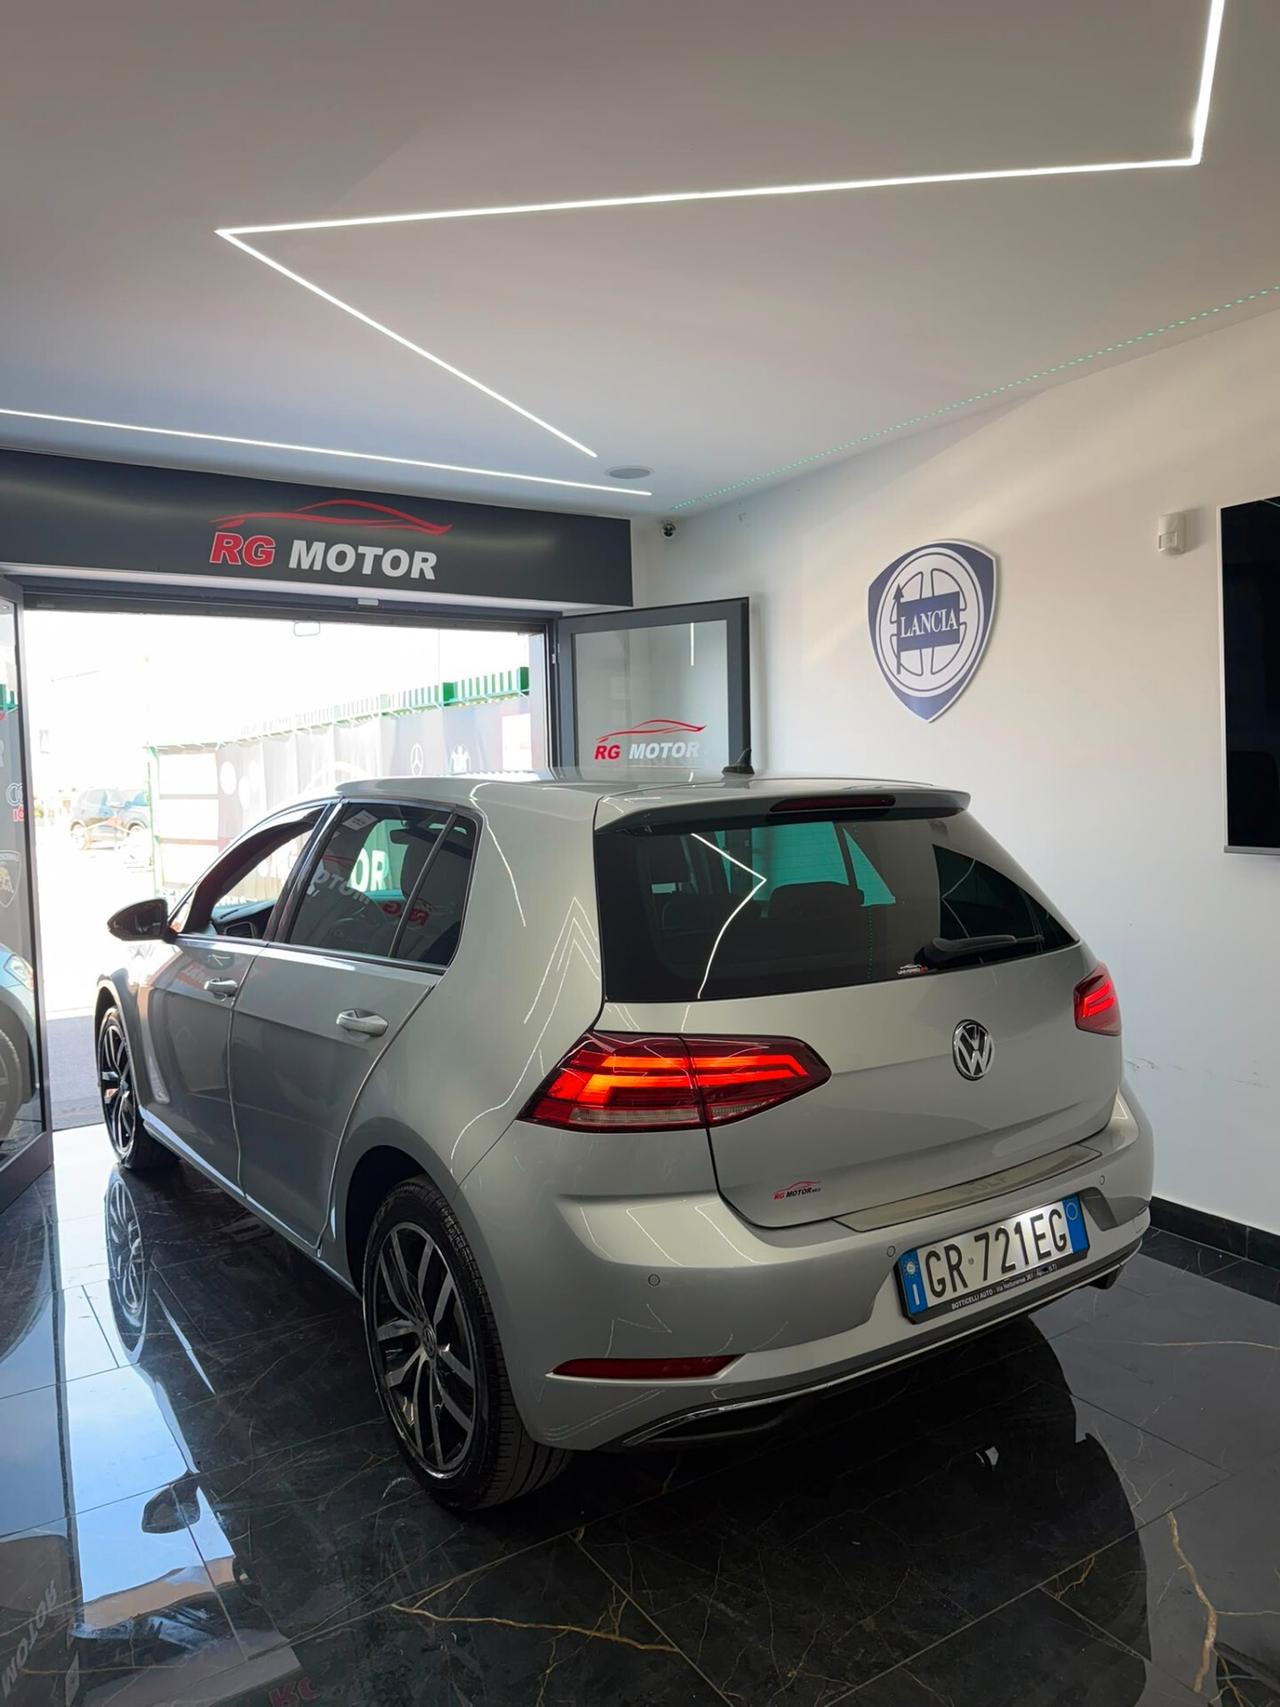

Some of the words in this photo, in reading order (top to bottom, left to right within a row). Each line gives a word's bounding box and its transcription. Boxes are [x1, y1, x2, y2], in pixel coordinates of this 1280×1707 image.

[209, 532, 276, 567] RG
[288, 539, 438, 580] MOTOR
[900, 608, 959, 638] LANCIA
[594, 744, 621, 760] RG
[628, 741, 701, 760] MOTOR
[774, 1191, 785, 1200] RG
[786, 1187, 812, 1198] MOTOR
[925, 1243, 968, 1298] GR
[974, 1208, 1067, 1282] 721EG
[951, 1293, 979, 1310] BOTTICELLI
[980, 1288, 994, 1299] AUTO
